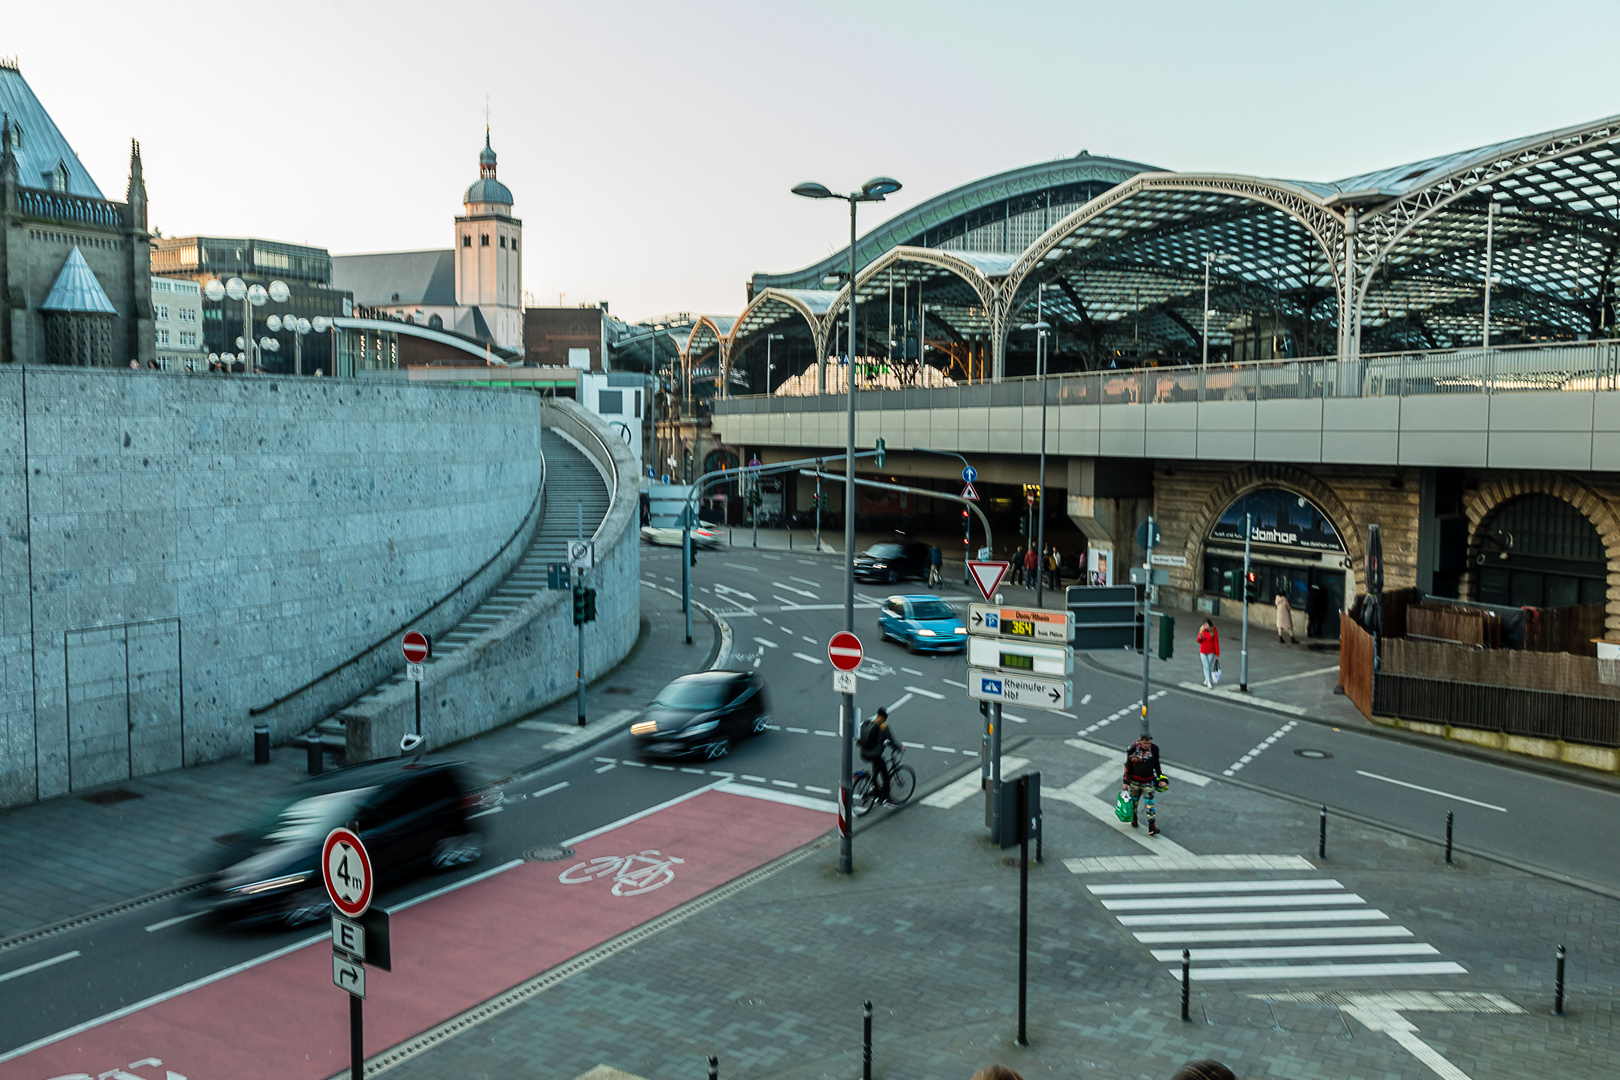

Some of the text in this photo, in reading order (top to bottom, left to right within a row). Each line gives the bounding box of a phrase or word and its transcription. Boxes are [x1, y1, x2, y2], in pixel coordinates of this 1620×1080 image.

[1015, 610, 1051, 622] Dom/Rhein
[1011, 620, 1033, 636] 364
[1004, 678, 1047, 693] Rheinufer
[1004, 690, 1019, 701] Hbf
[337, 854, 363, 891] 4 m
[340, 922, 355, 951] E
